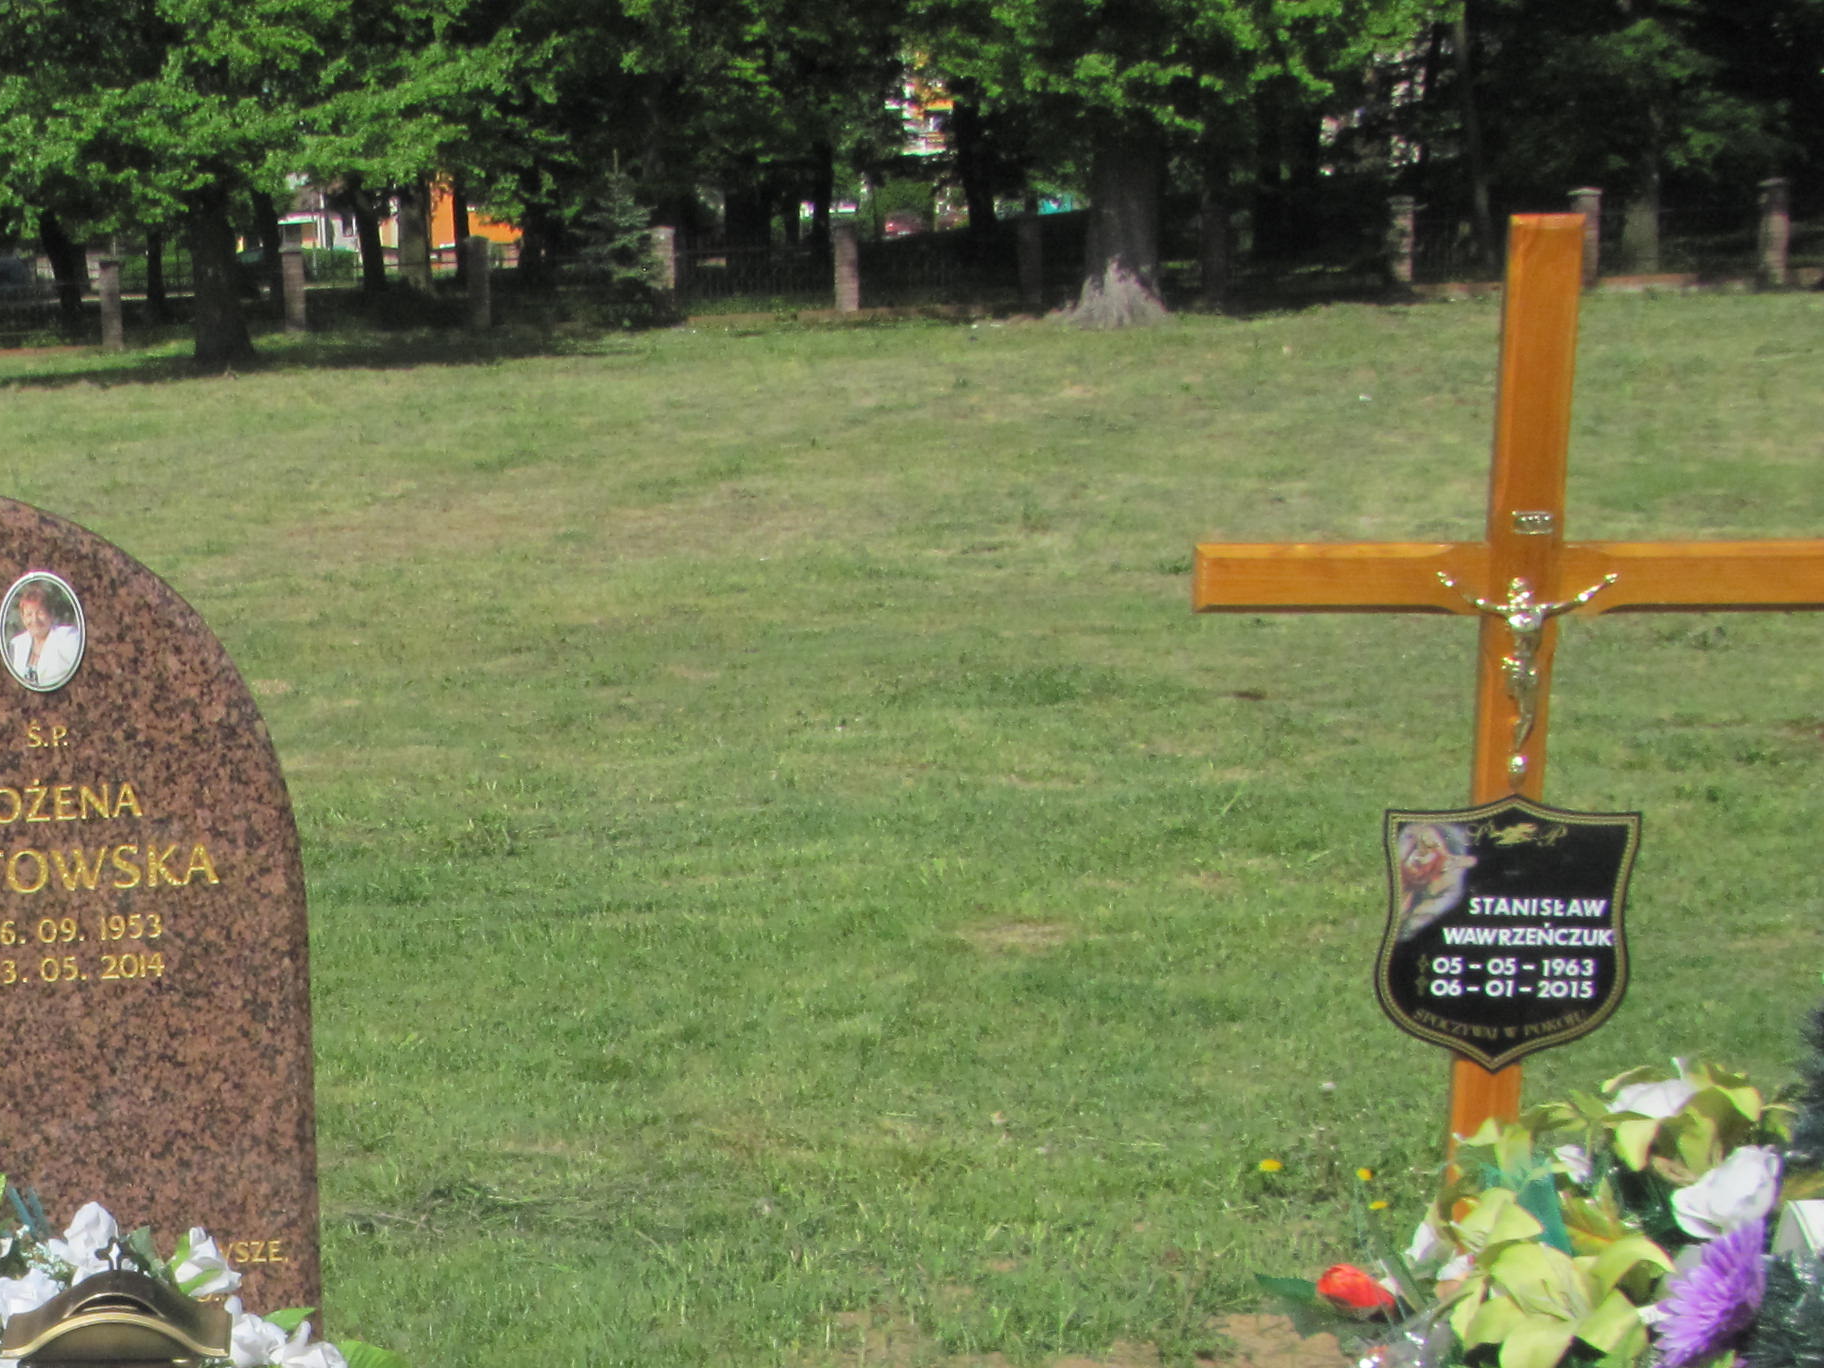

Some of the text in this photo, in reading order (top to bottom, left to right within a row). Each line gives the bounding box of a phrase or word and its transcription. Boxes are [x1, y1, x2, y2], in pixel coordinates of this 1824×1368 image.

[1469, 897, 1607, 917] STANISŁAW
[100, 914, 163, 940] 1953
[1442, 923, 1614, 946] WAWRZEŃCZUK
[100, 952, 165, 980] 2014
